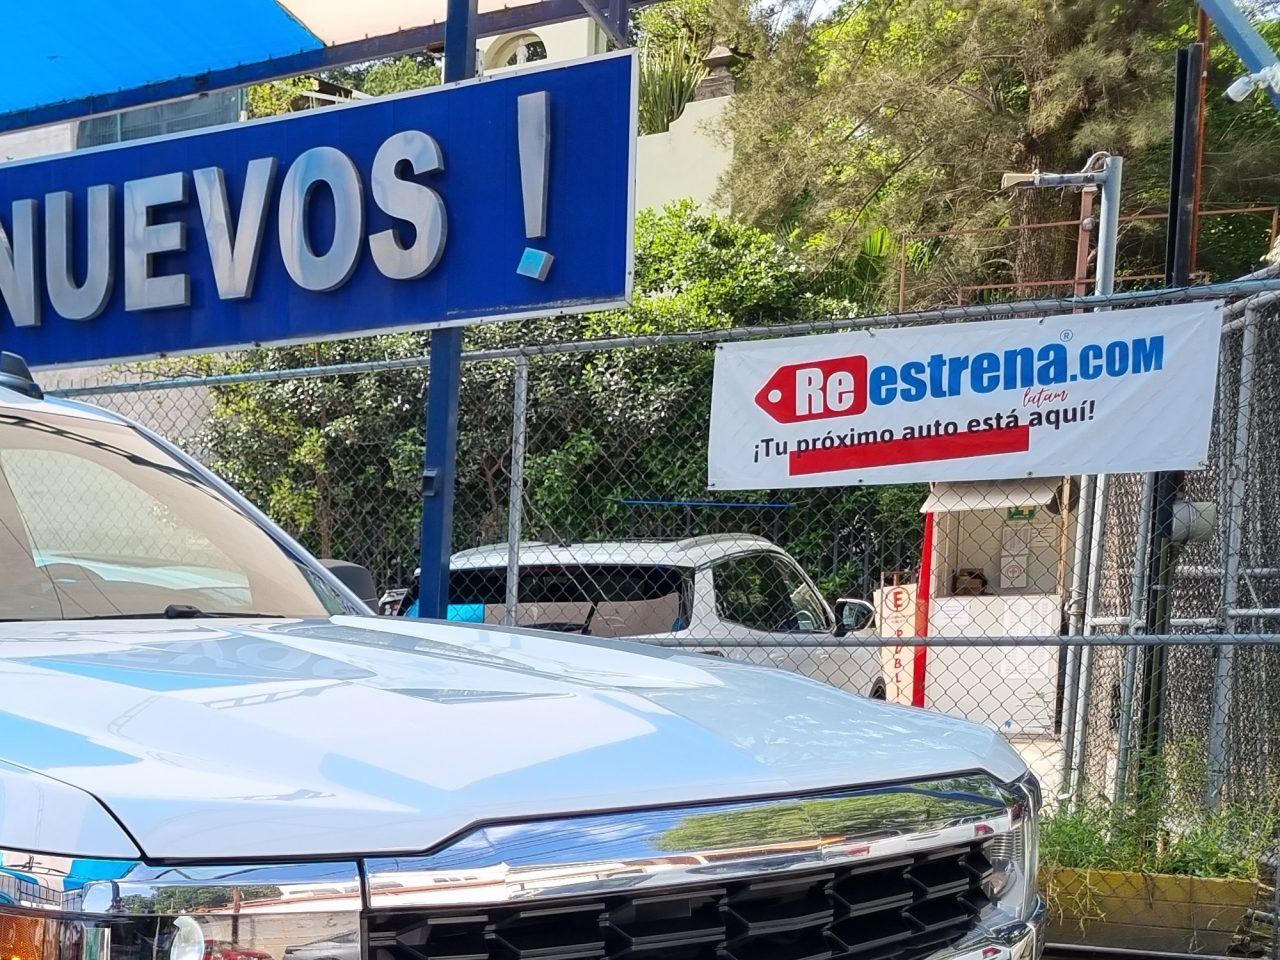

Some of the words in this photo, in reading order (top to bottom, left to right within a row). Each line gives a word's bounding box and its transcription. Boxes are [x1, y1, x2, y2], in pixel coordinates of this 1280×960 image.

[1023, 388, 1068, 408] latam
[753, 438, 788, 464] ¡Tu
[796, 427, 894, 457] próximo
[902, 418, 959, 442] auto
[967, 409, 1020, 434] está
[1028, 400, 1096, 432] aquí!
[893, 591, 904, 608] E
